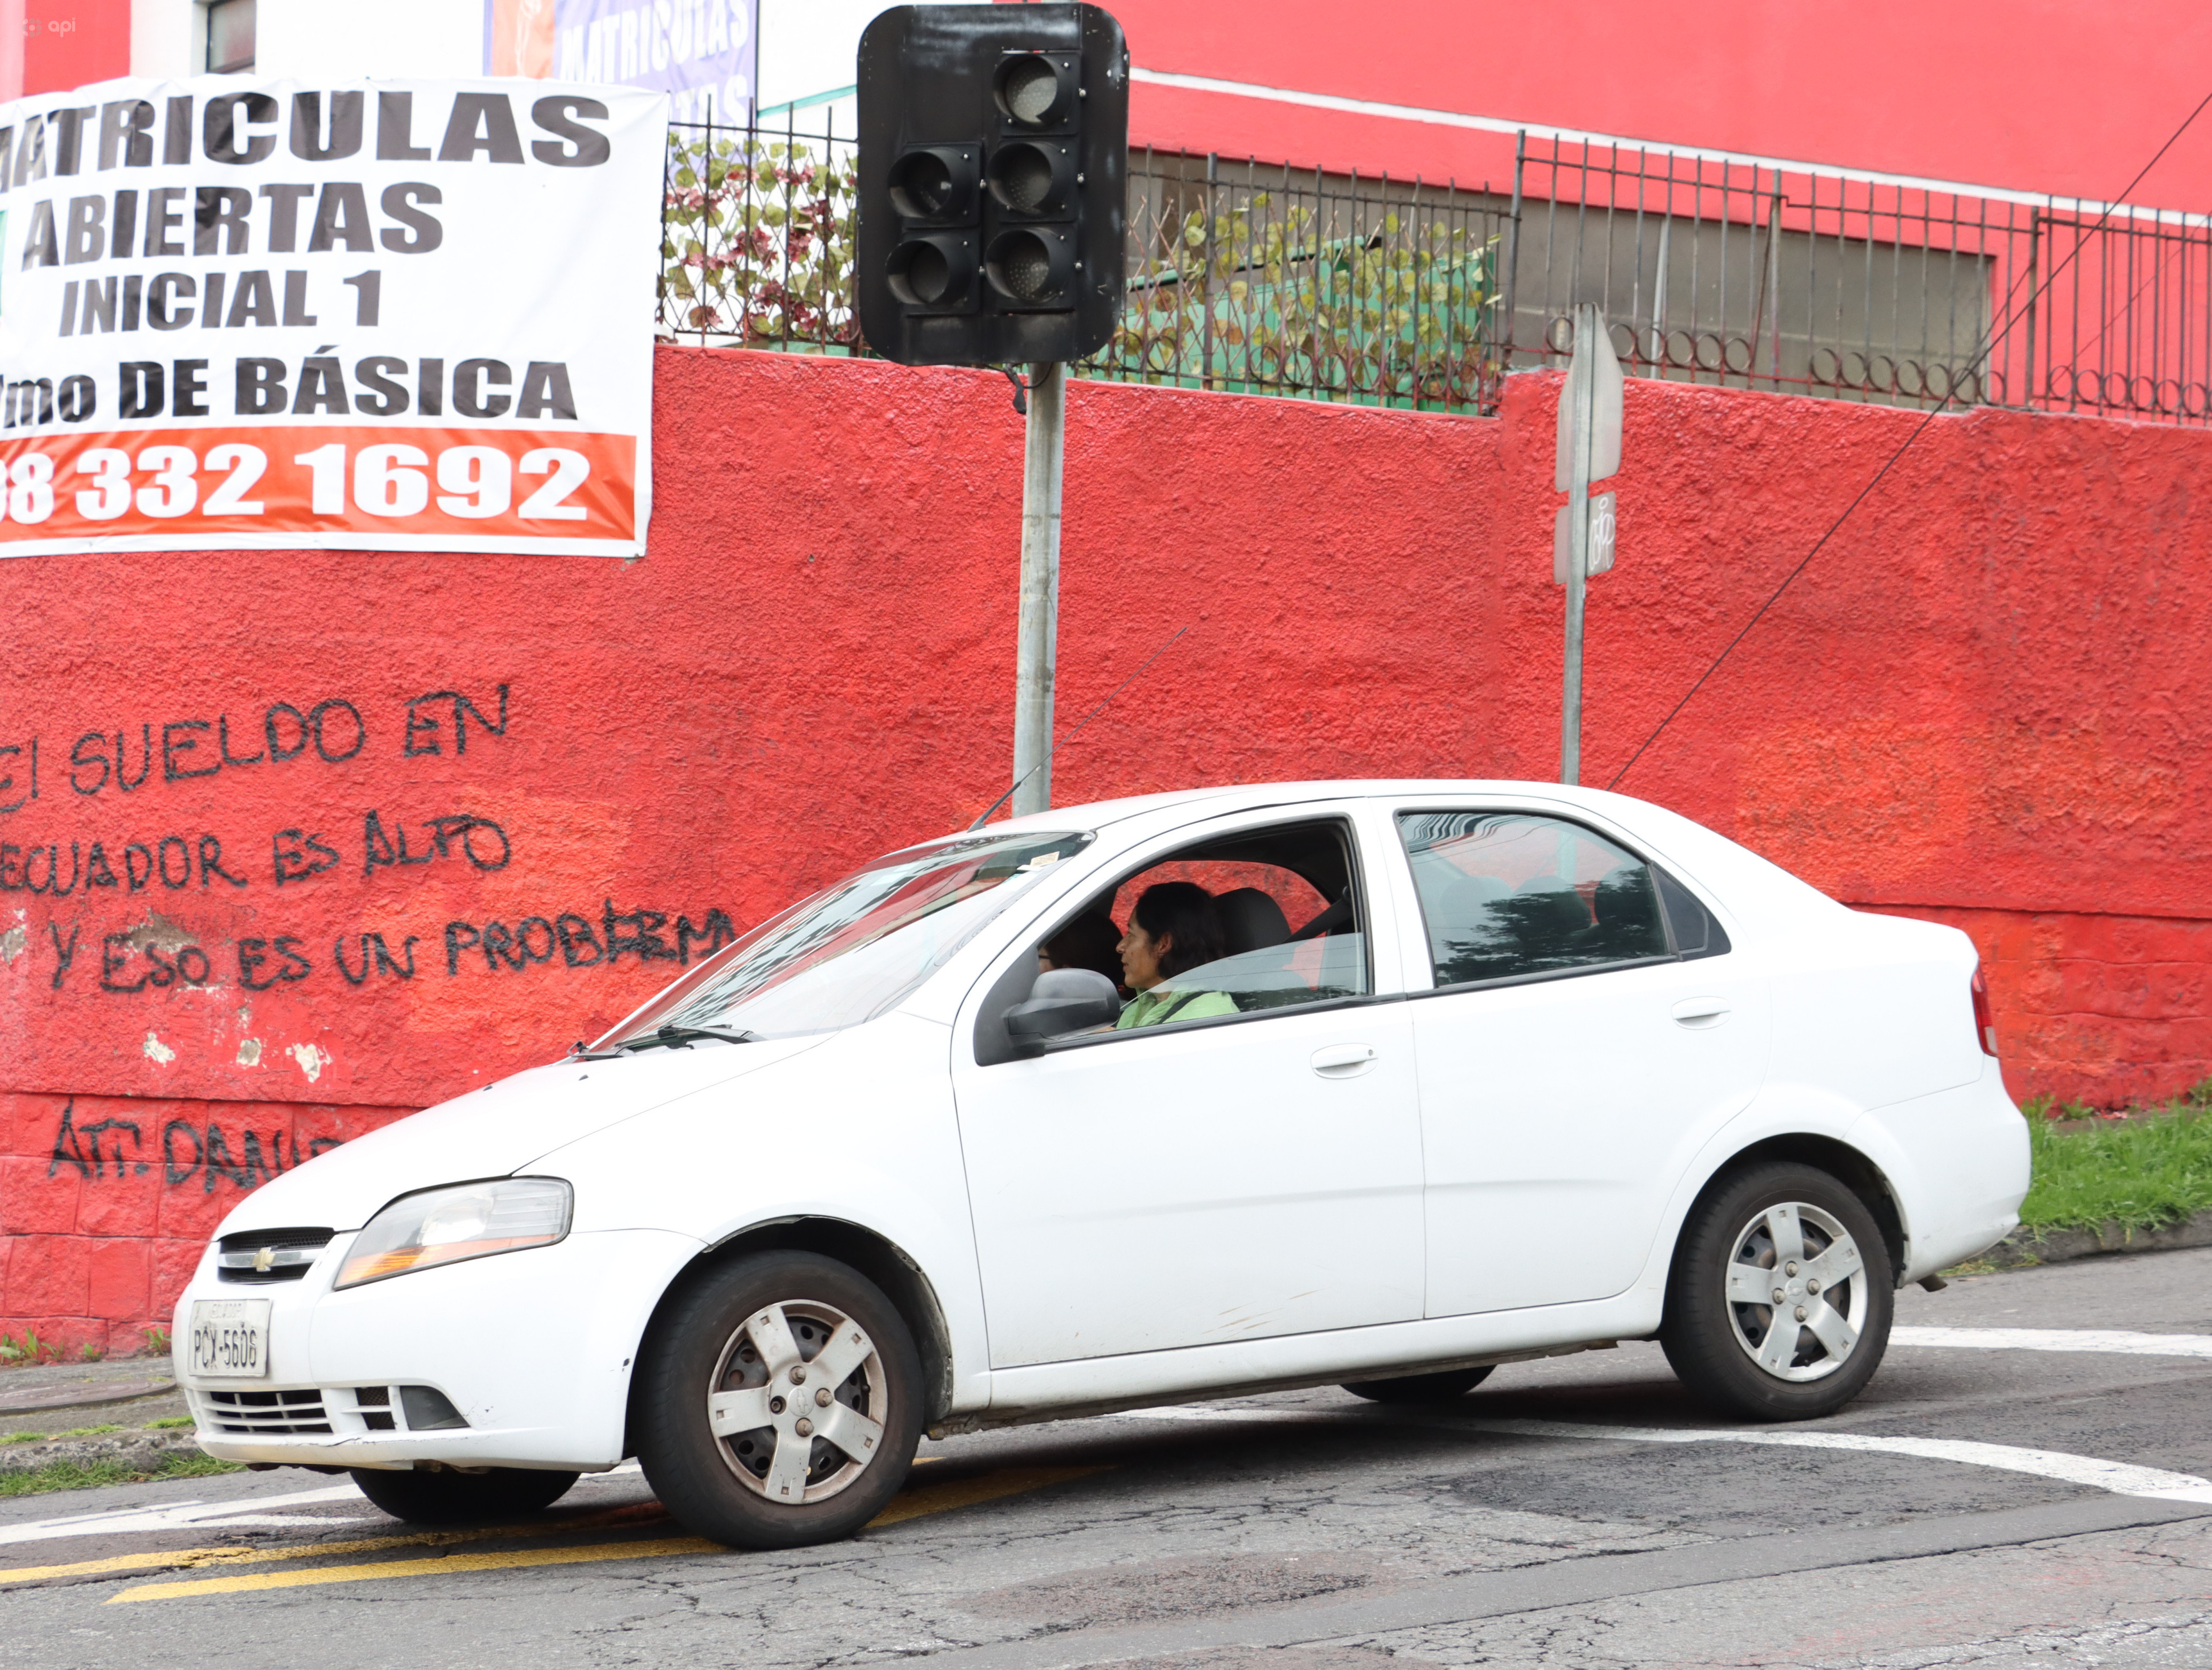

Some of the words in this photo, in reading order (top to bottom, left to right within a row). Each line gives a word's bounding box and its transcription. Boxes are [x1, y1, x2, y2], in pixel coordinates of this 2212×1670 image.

[21, 182, 443, 272] ABIERTAS
[58, 270, 318, 337] INICIAL
[343, 270, 381, 327] 1
[0, 373, 96, 428] mo
[119, 359, 210, 419] DE
[234, 345, 578, 420] BÁSICA
[0, 451, 55, 525] 8
[75, 443, 268, 521] 332
[294, 443, 590, 520] 1692
[70, 698, 366, 796] SUELDO
[403, 684, 510, 758] EN
[0, 840, 248, 897] ECUADOR
[273, 829, 340, 886] ES
[99, 934, 211, 993] ESO
[237, 936, 312, 991] ES
[334, 932, 420, 984] UN
